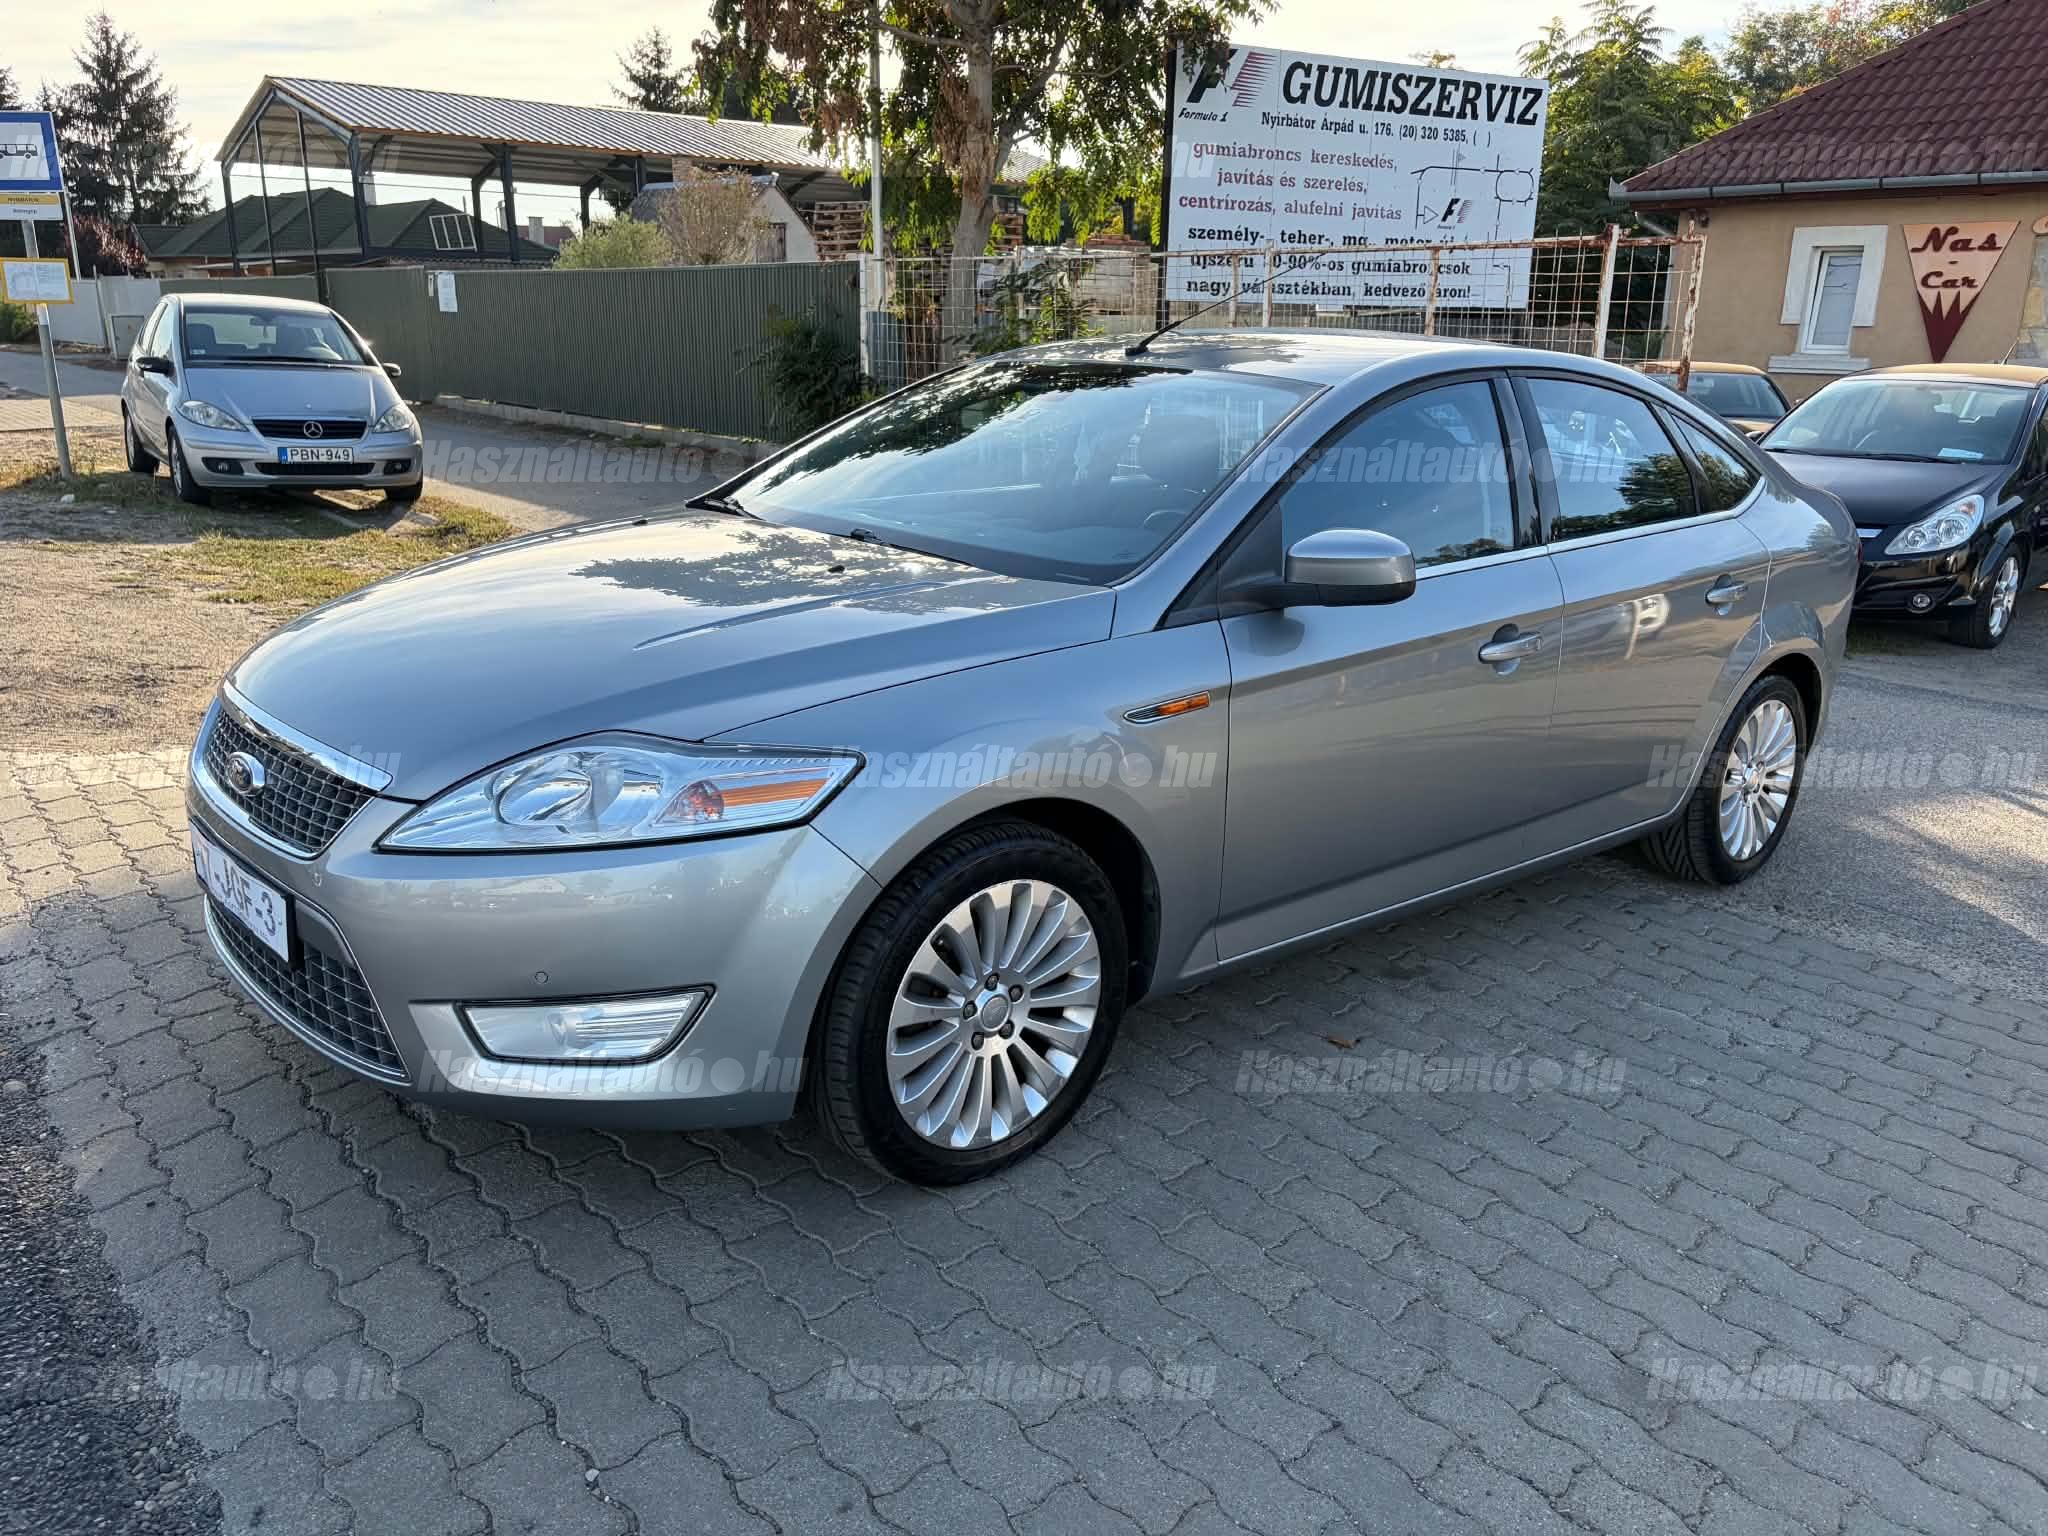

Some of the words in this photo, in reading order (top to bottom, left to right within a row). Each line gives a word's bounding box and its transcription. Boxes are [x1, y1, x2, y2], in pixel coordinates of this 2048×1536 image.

[1283, 61, 1544, 126] GUMISZERVIZ
[1178, 107, 1218, 122] Formula
[1219, 111, 1229, 122] 1
[1321, 113, 1354, 135] Árpád
[1359, 123, 1369, 134] u.
[1374, 121, 1394, 137] 176.
[1400, 124, 1418, 141] (20)
[1420, 126, 1439, 141] 320
[1442, 128, 1469, 144] 5385,
[1193, 141, 1302, 162] gumiabroncs
[1310, 148, 1398, 173] kereskedés,
[1217, 167, 1273, 187] javítás
[1280, 171, 1296, 188] és
[1303, 176, 1367, 195] szerelés,
[1179, 194, 1276, 217] centrírozás,
[1284, 199, 1344, 217] alufelni
[1188, 224, 1265, 246] személy-
[1280, 229, 1334, 247] teher-,
[1910, 226, 2003, 252] Nas
[1264, 253, 1344, 272] 0-90%-os
[1351, 258, 1471, 277] gumiabrocsok
[1186, 280, 1231, 297] nagy
[1921, 270, 1979, 289] Car
[289, 447, 351, 461] PBN-949
